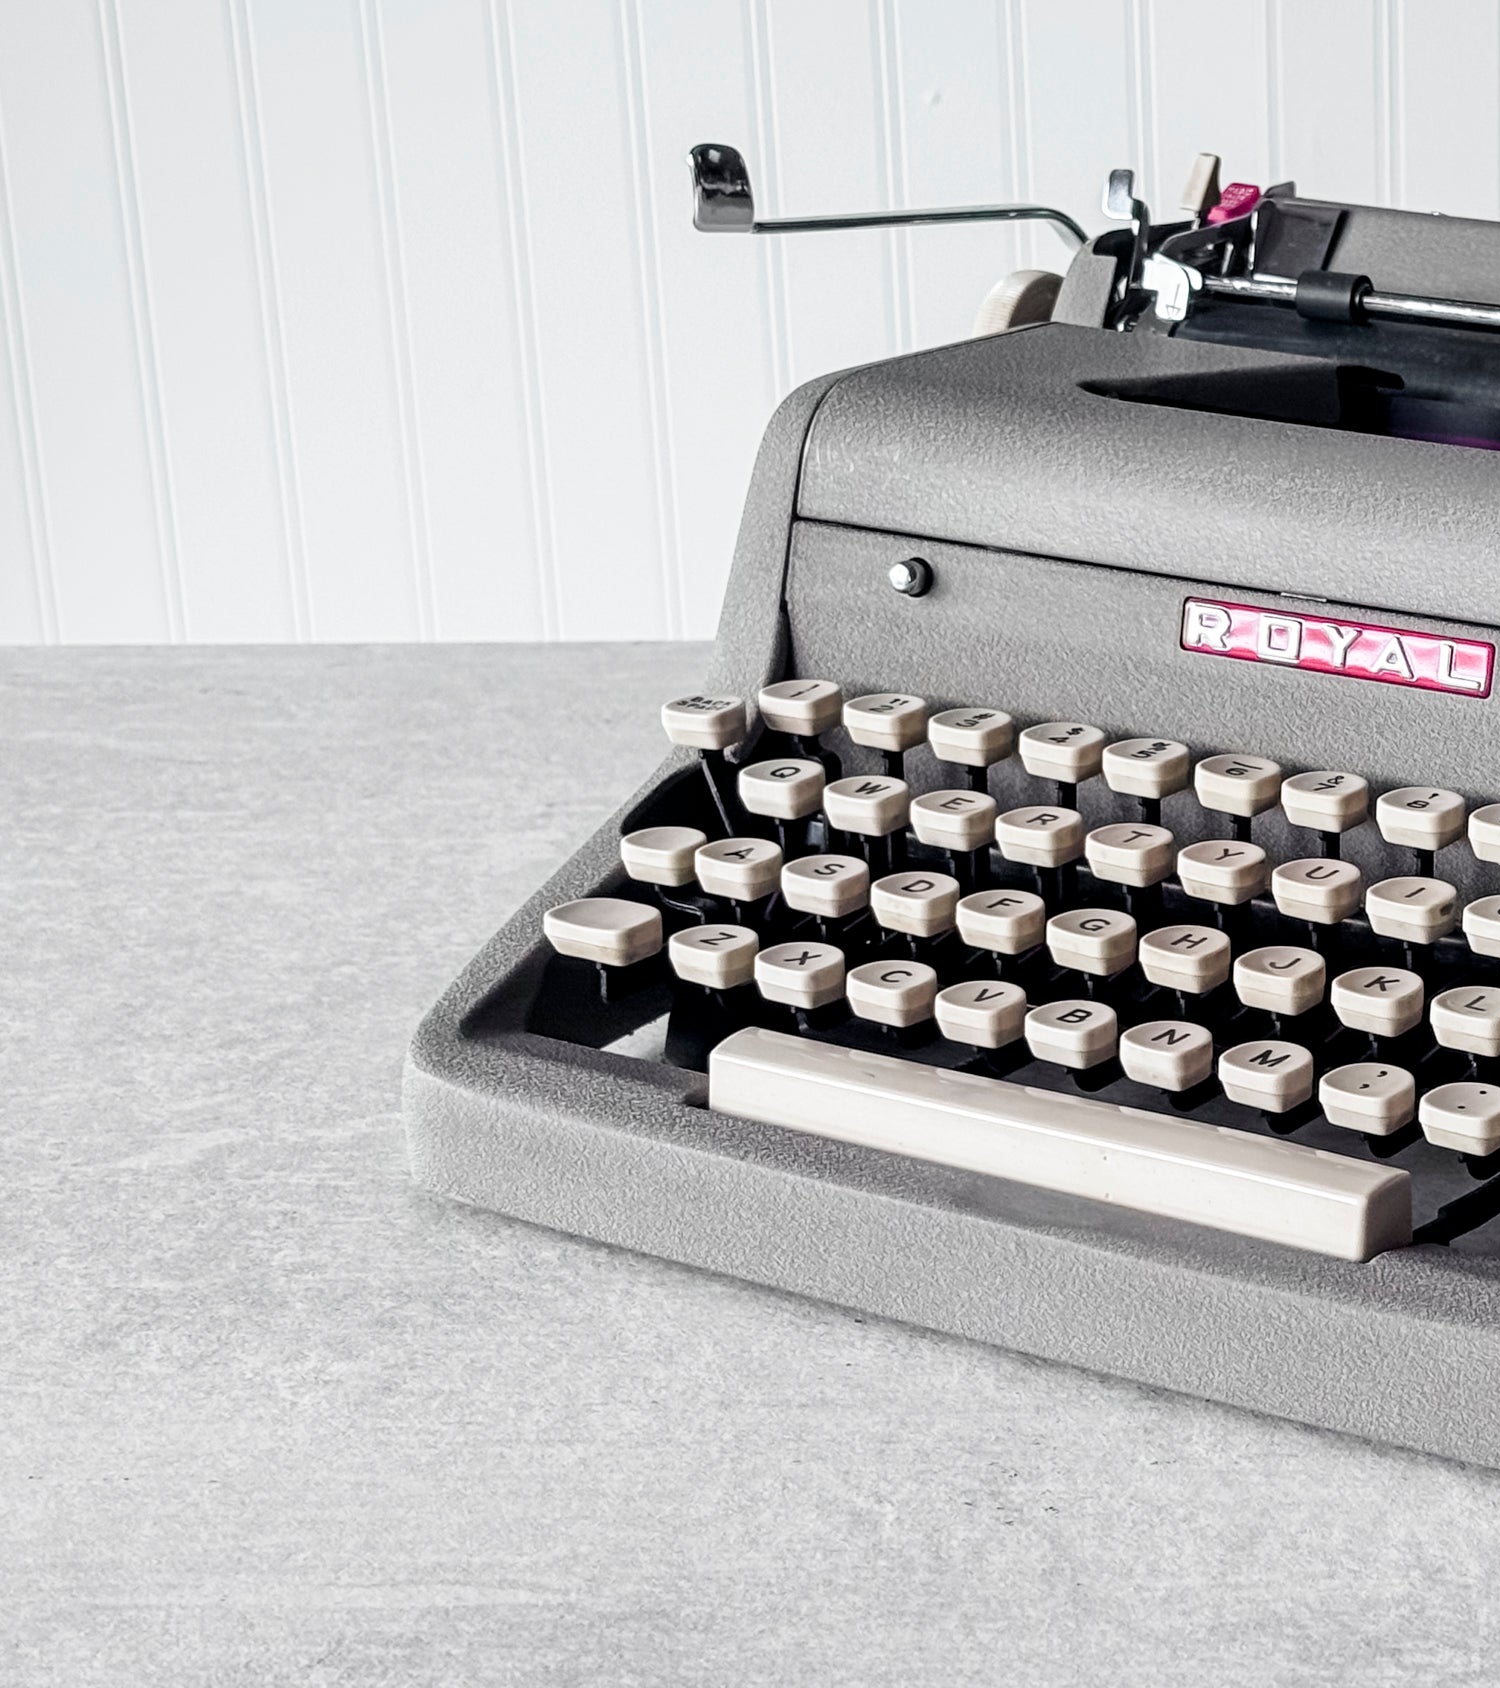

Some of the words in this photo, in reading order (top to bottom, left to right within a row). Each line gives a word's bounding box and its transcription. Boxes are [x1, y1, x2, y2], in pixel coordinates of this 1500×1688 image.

[1184, 601, 1486, 692] ROYAL
[770, 767, 800, 778] Q
[855, 782, 893, 797] W
[940, 798, 974, 810] E
[1026, 814, 1058, 825] R
[1123, 831, 1152, 842] T
[723, 847, 753, 859] A
[1215, 849, 1244, 860] Y
[814, 864, 845, 875] S
[1306, 866, 1339, 879] U
[901, 880, 934, 892] D
[1405, 888, 1425, 897] I
[986, 898, 1023, 908] F
[1079, 919, 1110, 931] G
[700, 933, 737, 945] Z
[1170, 934, 1207, 948] H
[784, 951, 821, 965] X
[1269, 958, 1301, 969] J
[881, 971, 912, 982] C
[1364, 976, 1399, 991] K
[974, 989, 1004, 1002] V
[1464, 996, 1485, 1011] L
[1056, 1009, 1092, 1023] B
[1151, 1029, 1190, 1045] N
[1249, 1050, 1290, 1067] M
